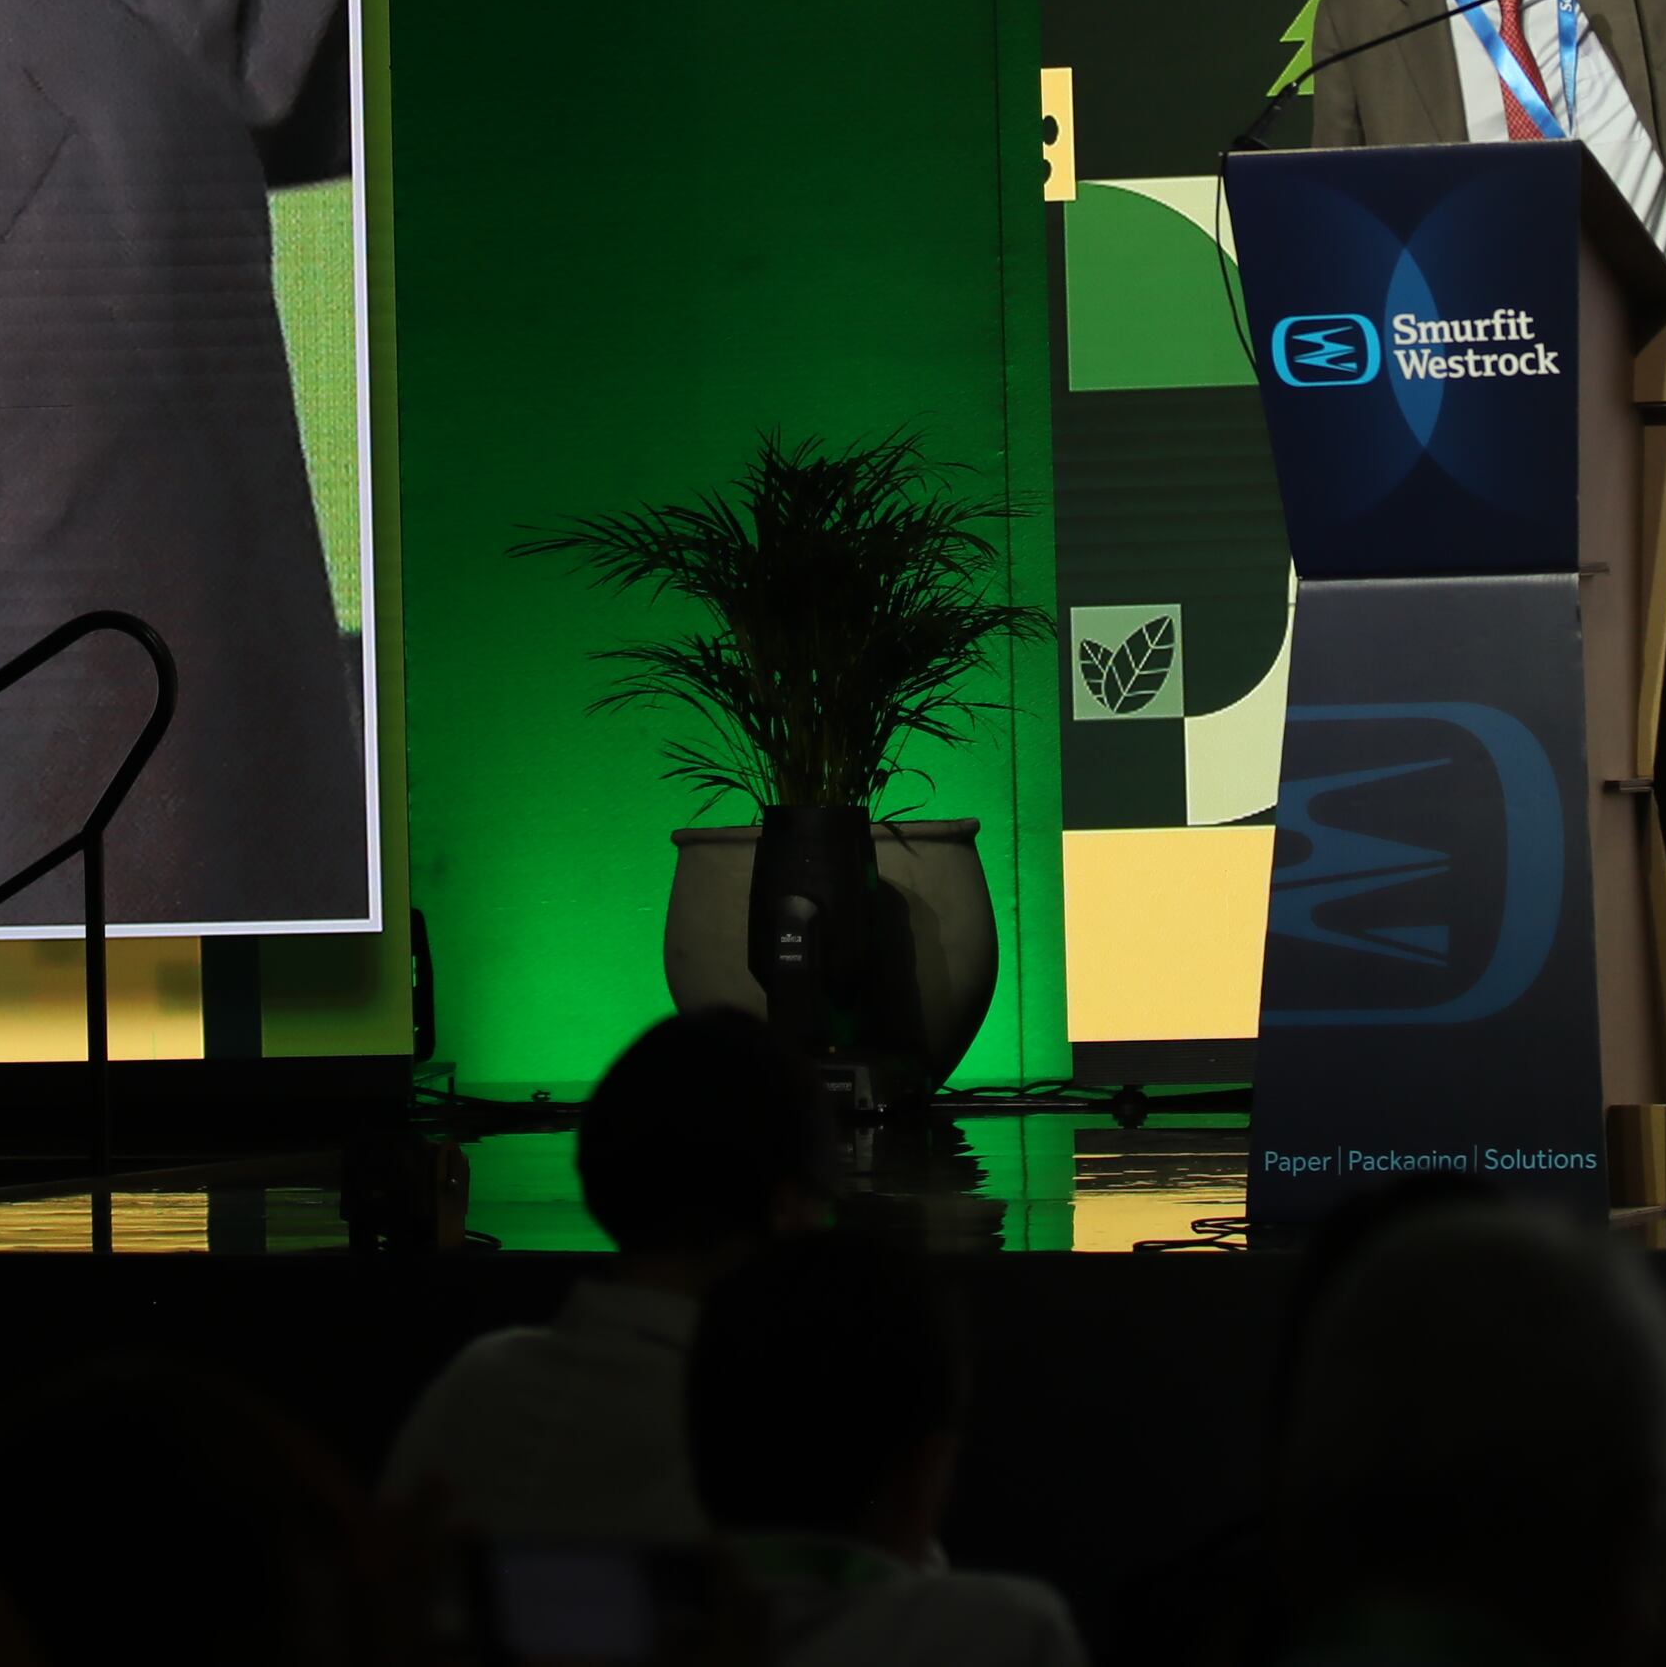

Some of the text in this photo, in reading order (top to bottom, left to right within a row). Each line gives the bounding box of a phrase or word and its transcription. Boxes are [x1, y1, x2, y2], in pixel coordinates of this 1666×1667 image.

[1392, 309, 1536, 345] Smurfit
[1393, 343, 1560, 380] Westrock
[1263, 1147, 1598, 1177] Paper Packaging Solutions
